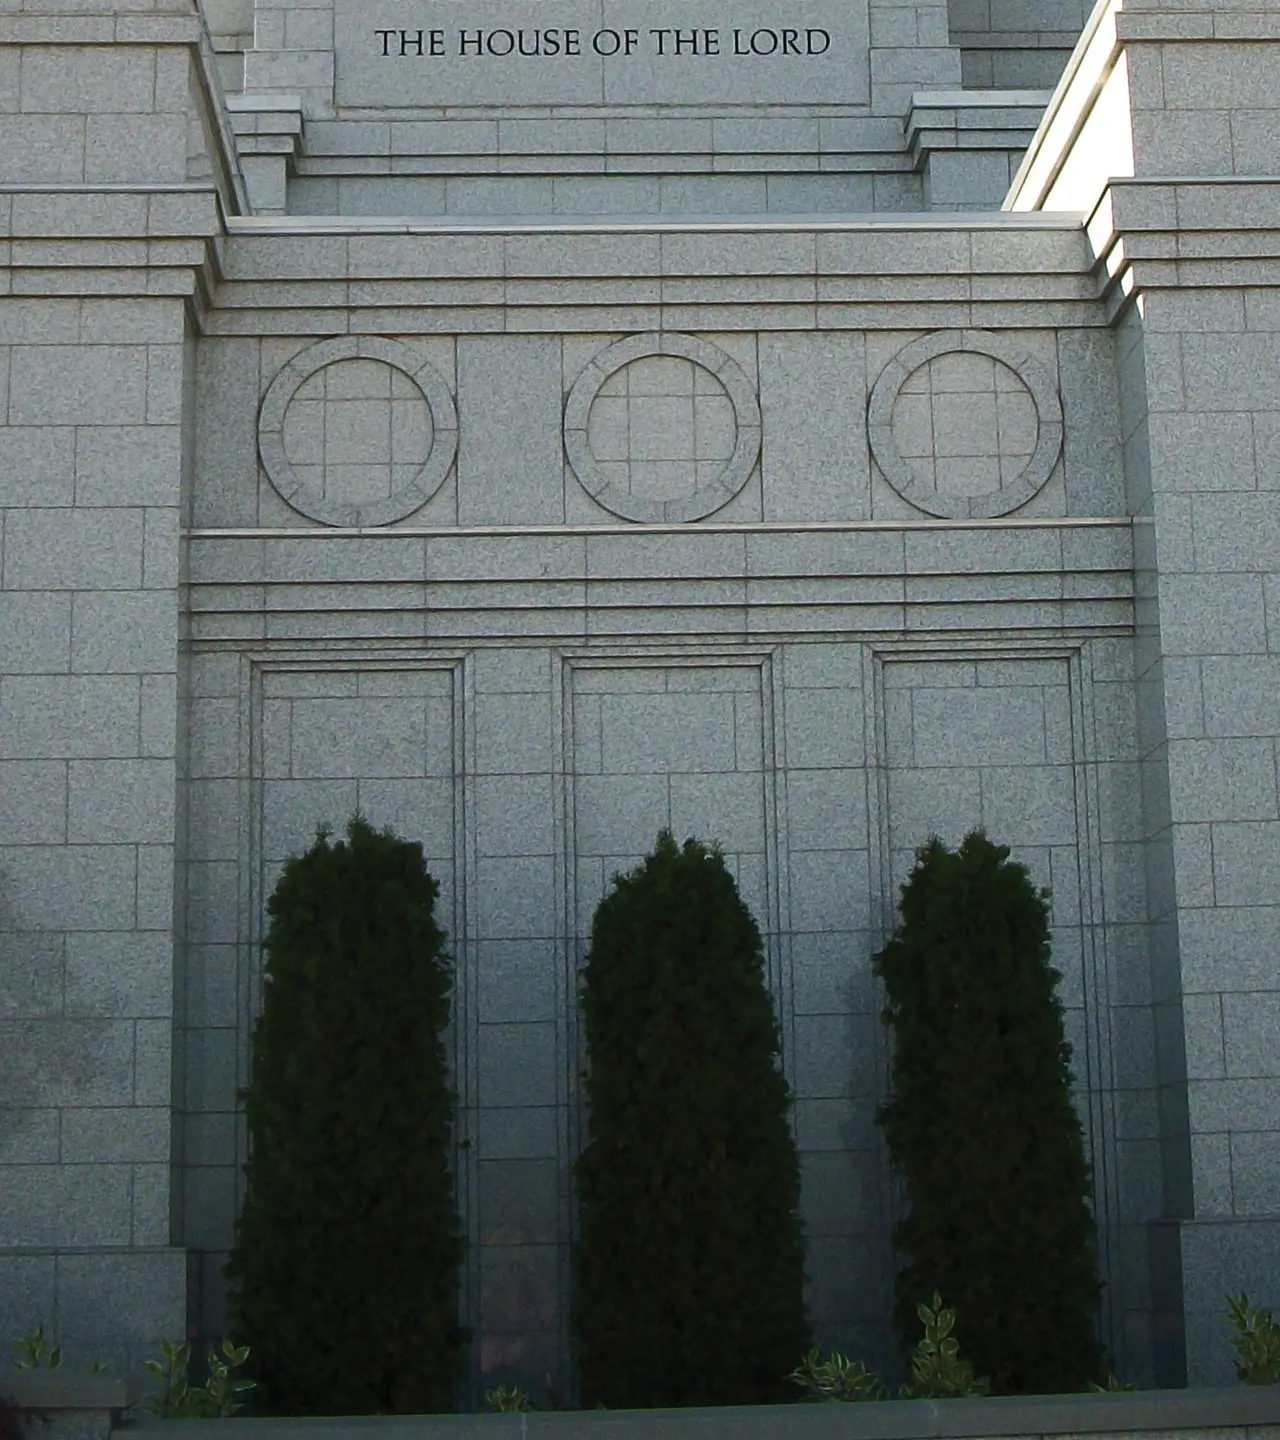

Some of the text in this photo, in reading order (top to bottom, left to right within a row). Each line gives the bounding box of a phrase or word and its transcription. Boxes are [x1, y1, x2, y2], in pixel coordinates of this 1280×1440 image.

[374, 28, 832, 57] THE HOUSE OF THE LORD
